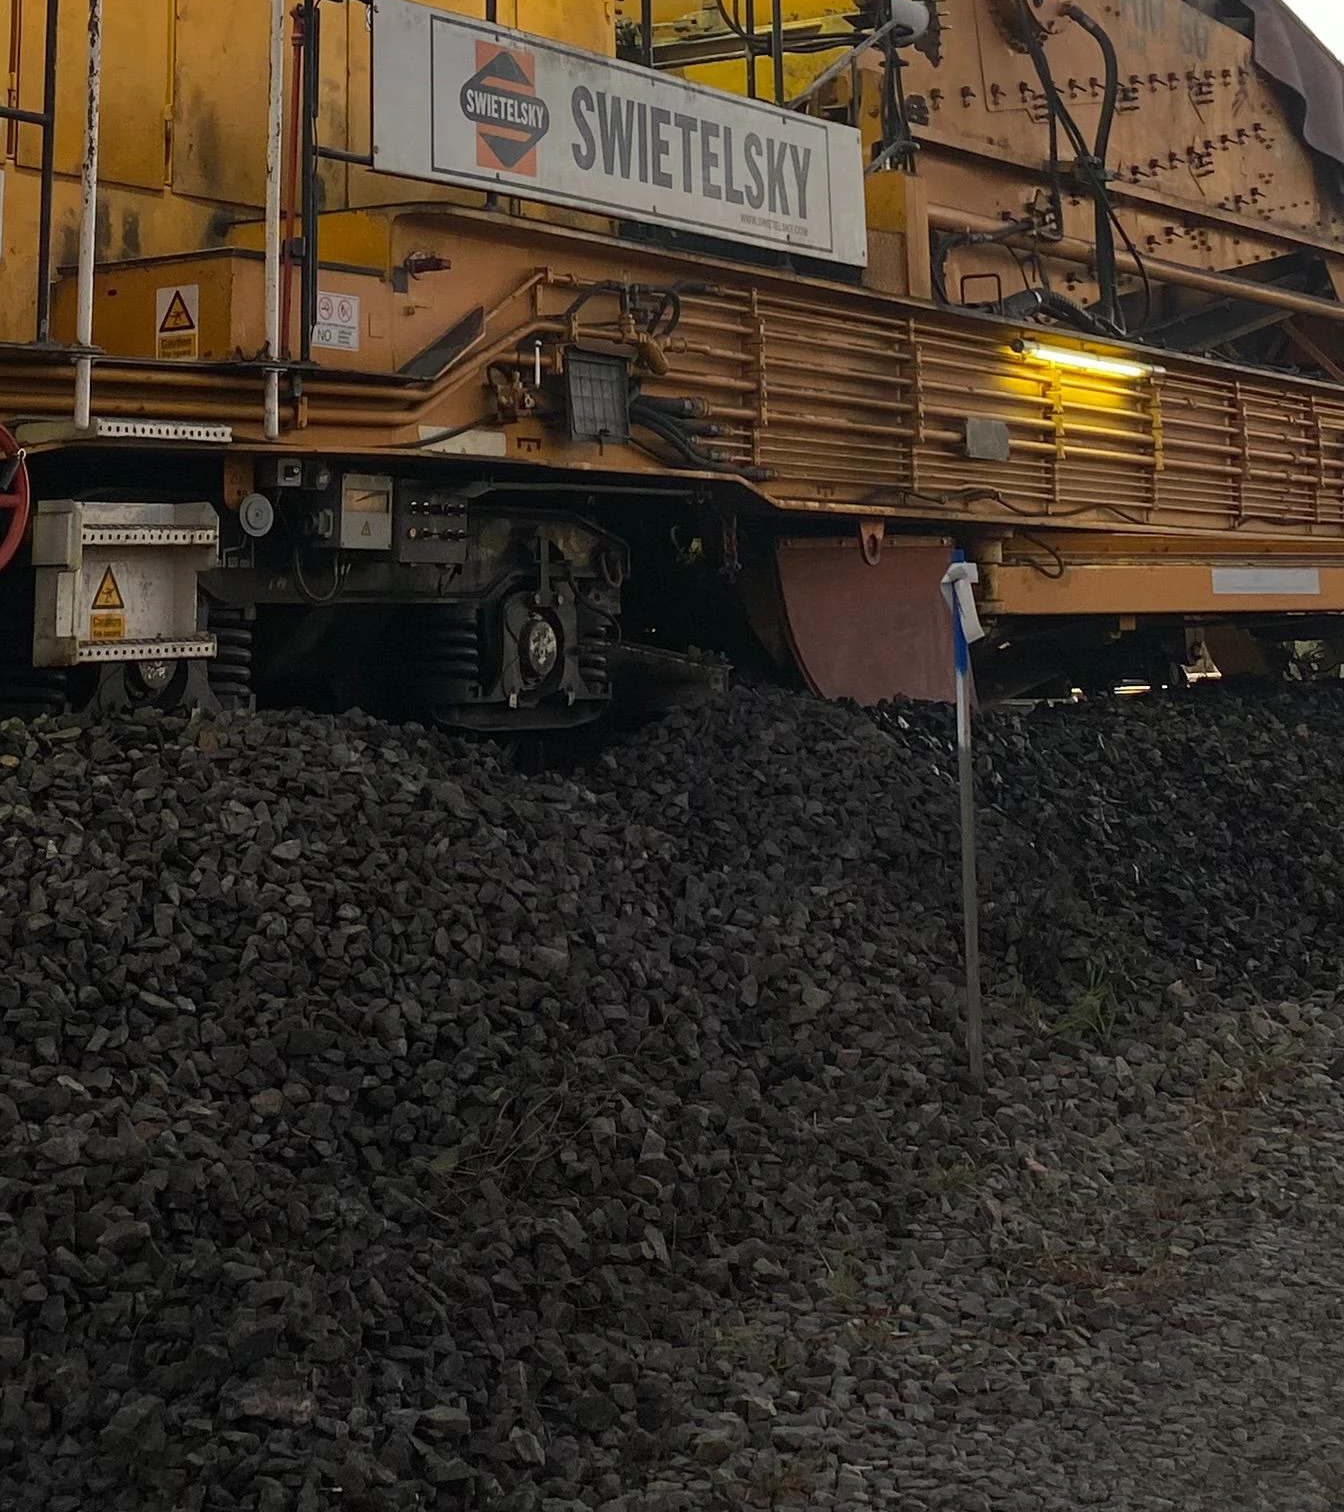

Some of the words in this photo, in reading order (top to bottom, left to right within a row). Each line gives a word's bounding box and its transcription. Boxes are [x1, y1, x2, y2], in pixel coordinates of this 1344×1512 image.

[466, 88, 544, 129] SWIETELSKY
[571, 85, 812, 220] SWIETELSKY
[317, 329, 333, 342] NO
